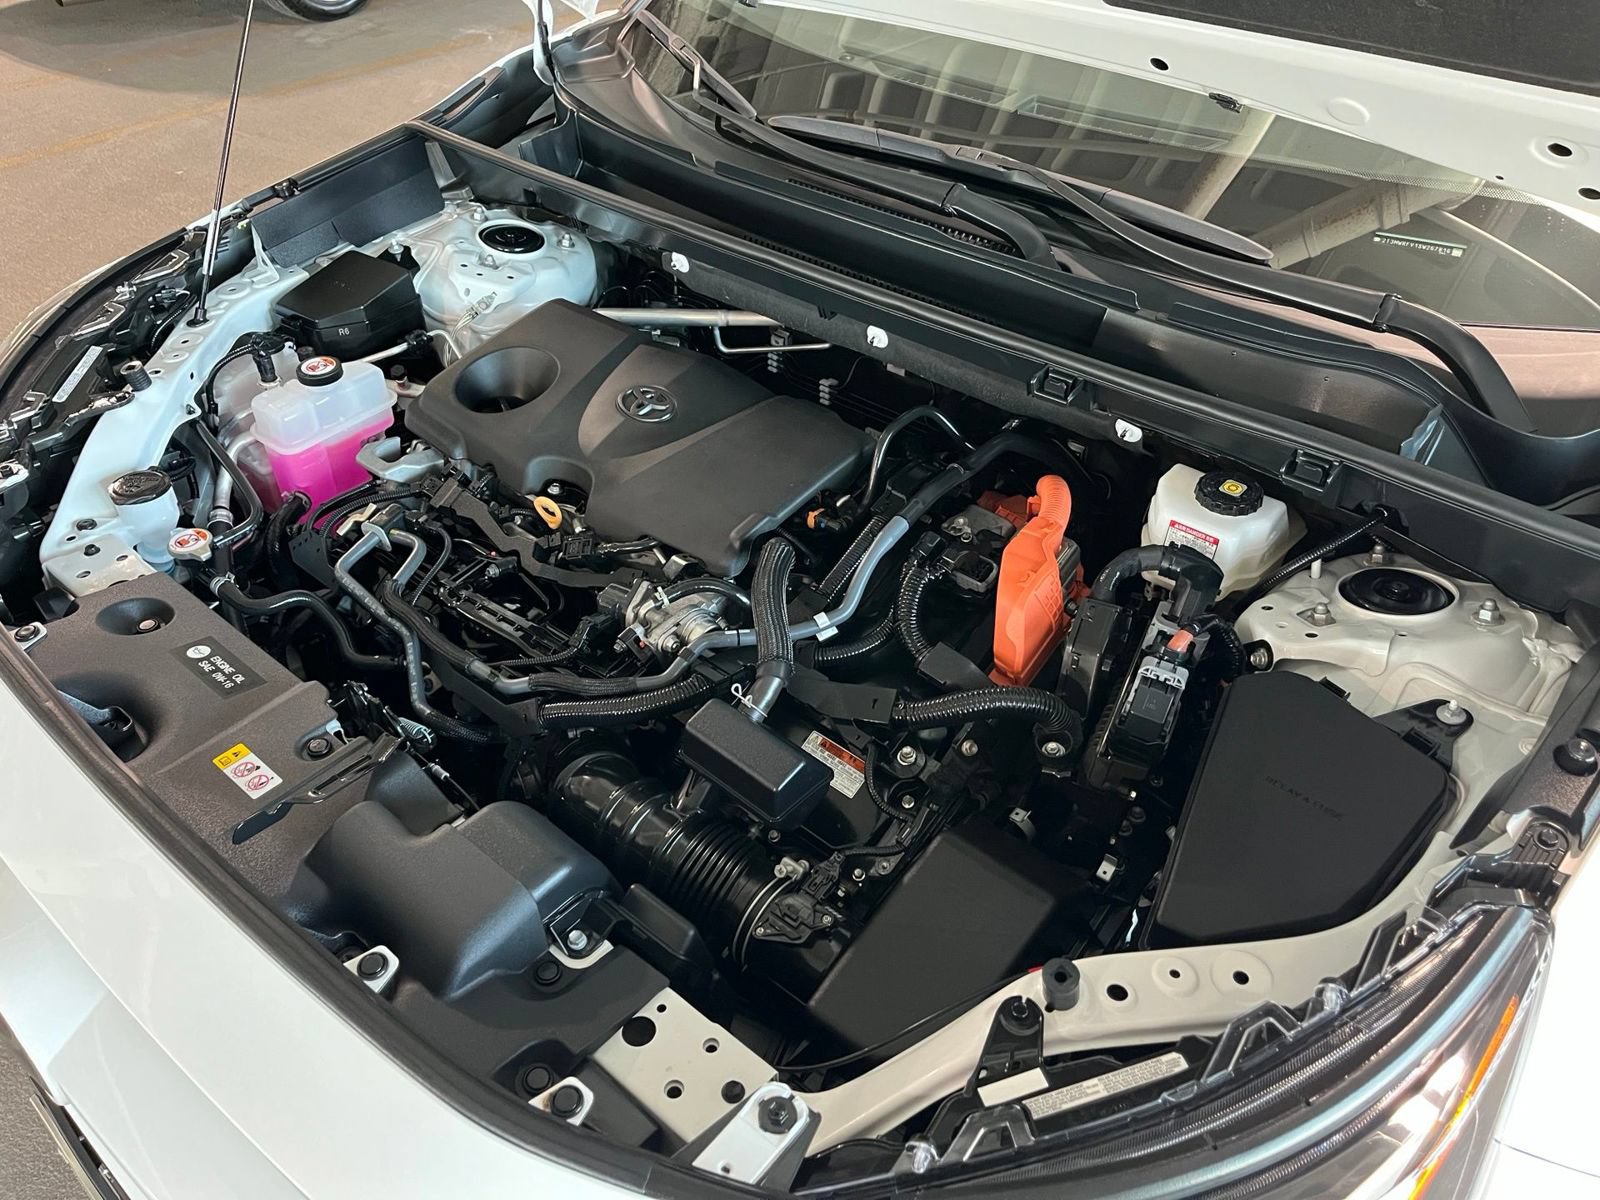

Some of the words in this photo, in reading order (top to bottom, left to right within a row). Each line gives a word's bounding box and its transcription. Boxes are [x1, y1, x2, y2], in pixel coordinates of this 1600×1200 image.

[338, 327, 350, 336] R6
[198, 660, 215, 672] SAE
[212, 671, 235, 689] 0W-16
[210, 655, 236, 675] ENGINE
[232, 673, 246, 684] OIL
